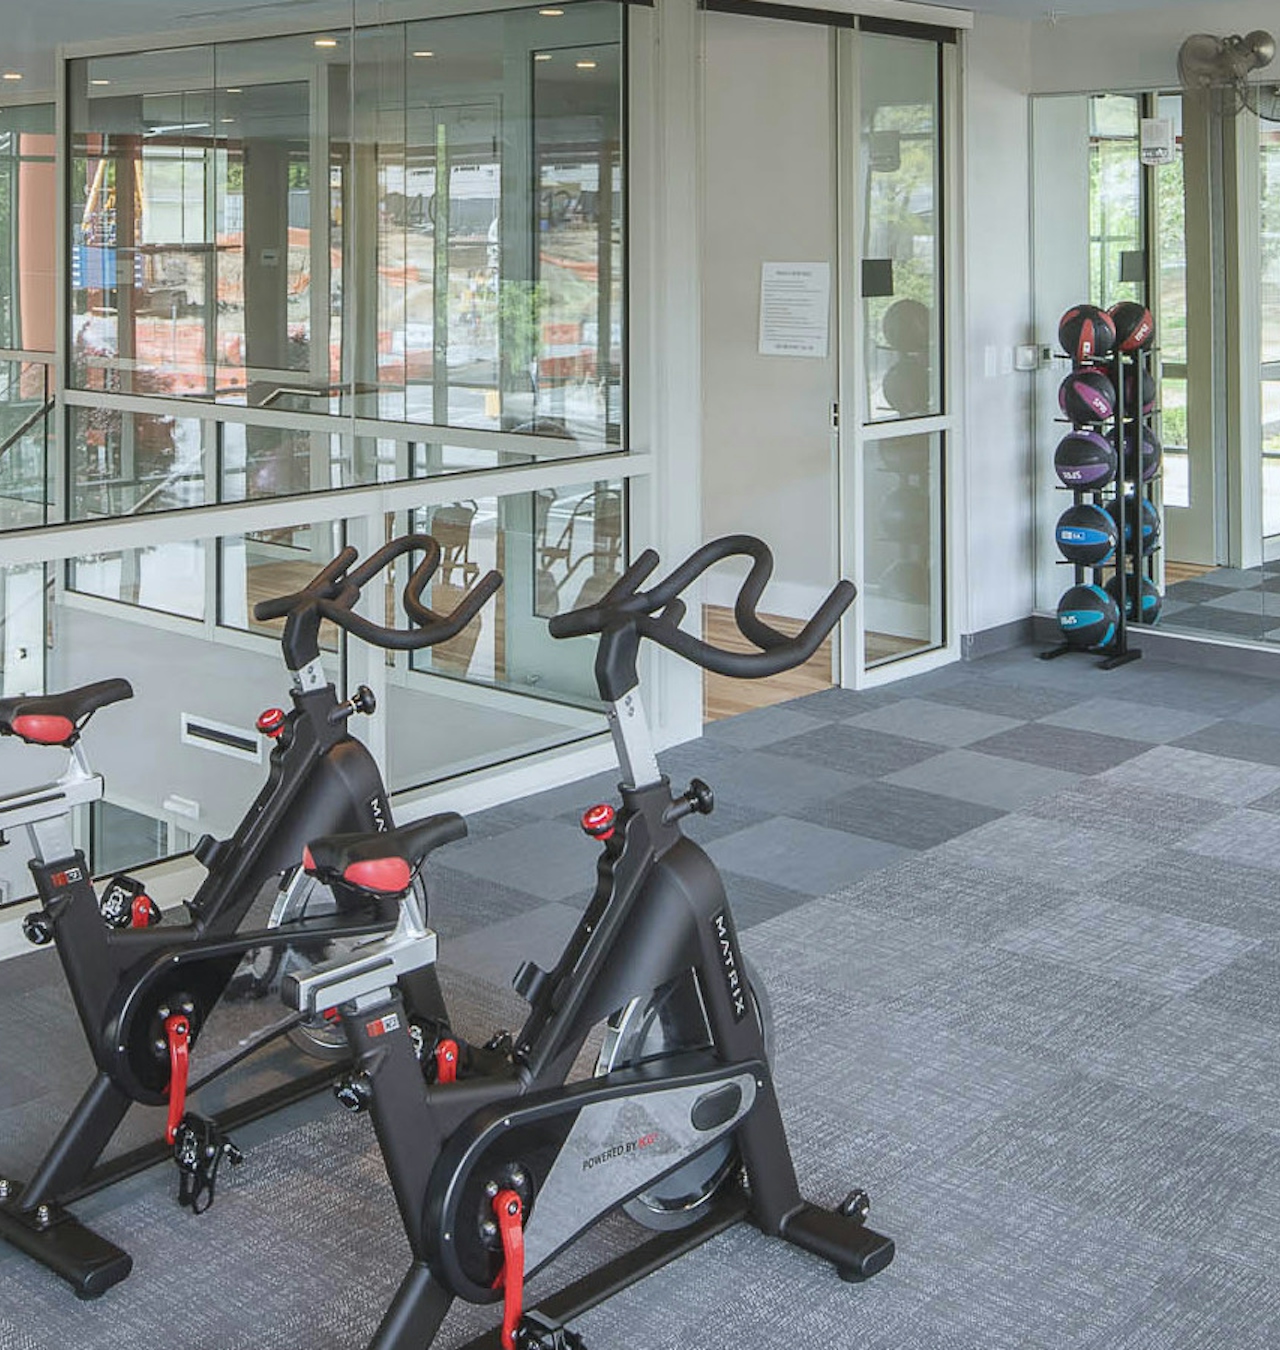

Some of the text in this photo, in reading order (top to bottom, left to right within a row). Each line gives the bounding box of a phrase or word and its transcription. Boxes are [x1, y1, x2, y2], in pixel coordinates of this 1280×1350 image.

[714, 914, 746, 1017] MATRIX
[582, 1144, 624, 1172] POWERED
[625, 1140, 638, 1153] BY
